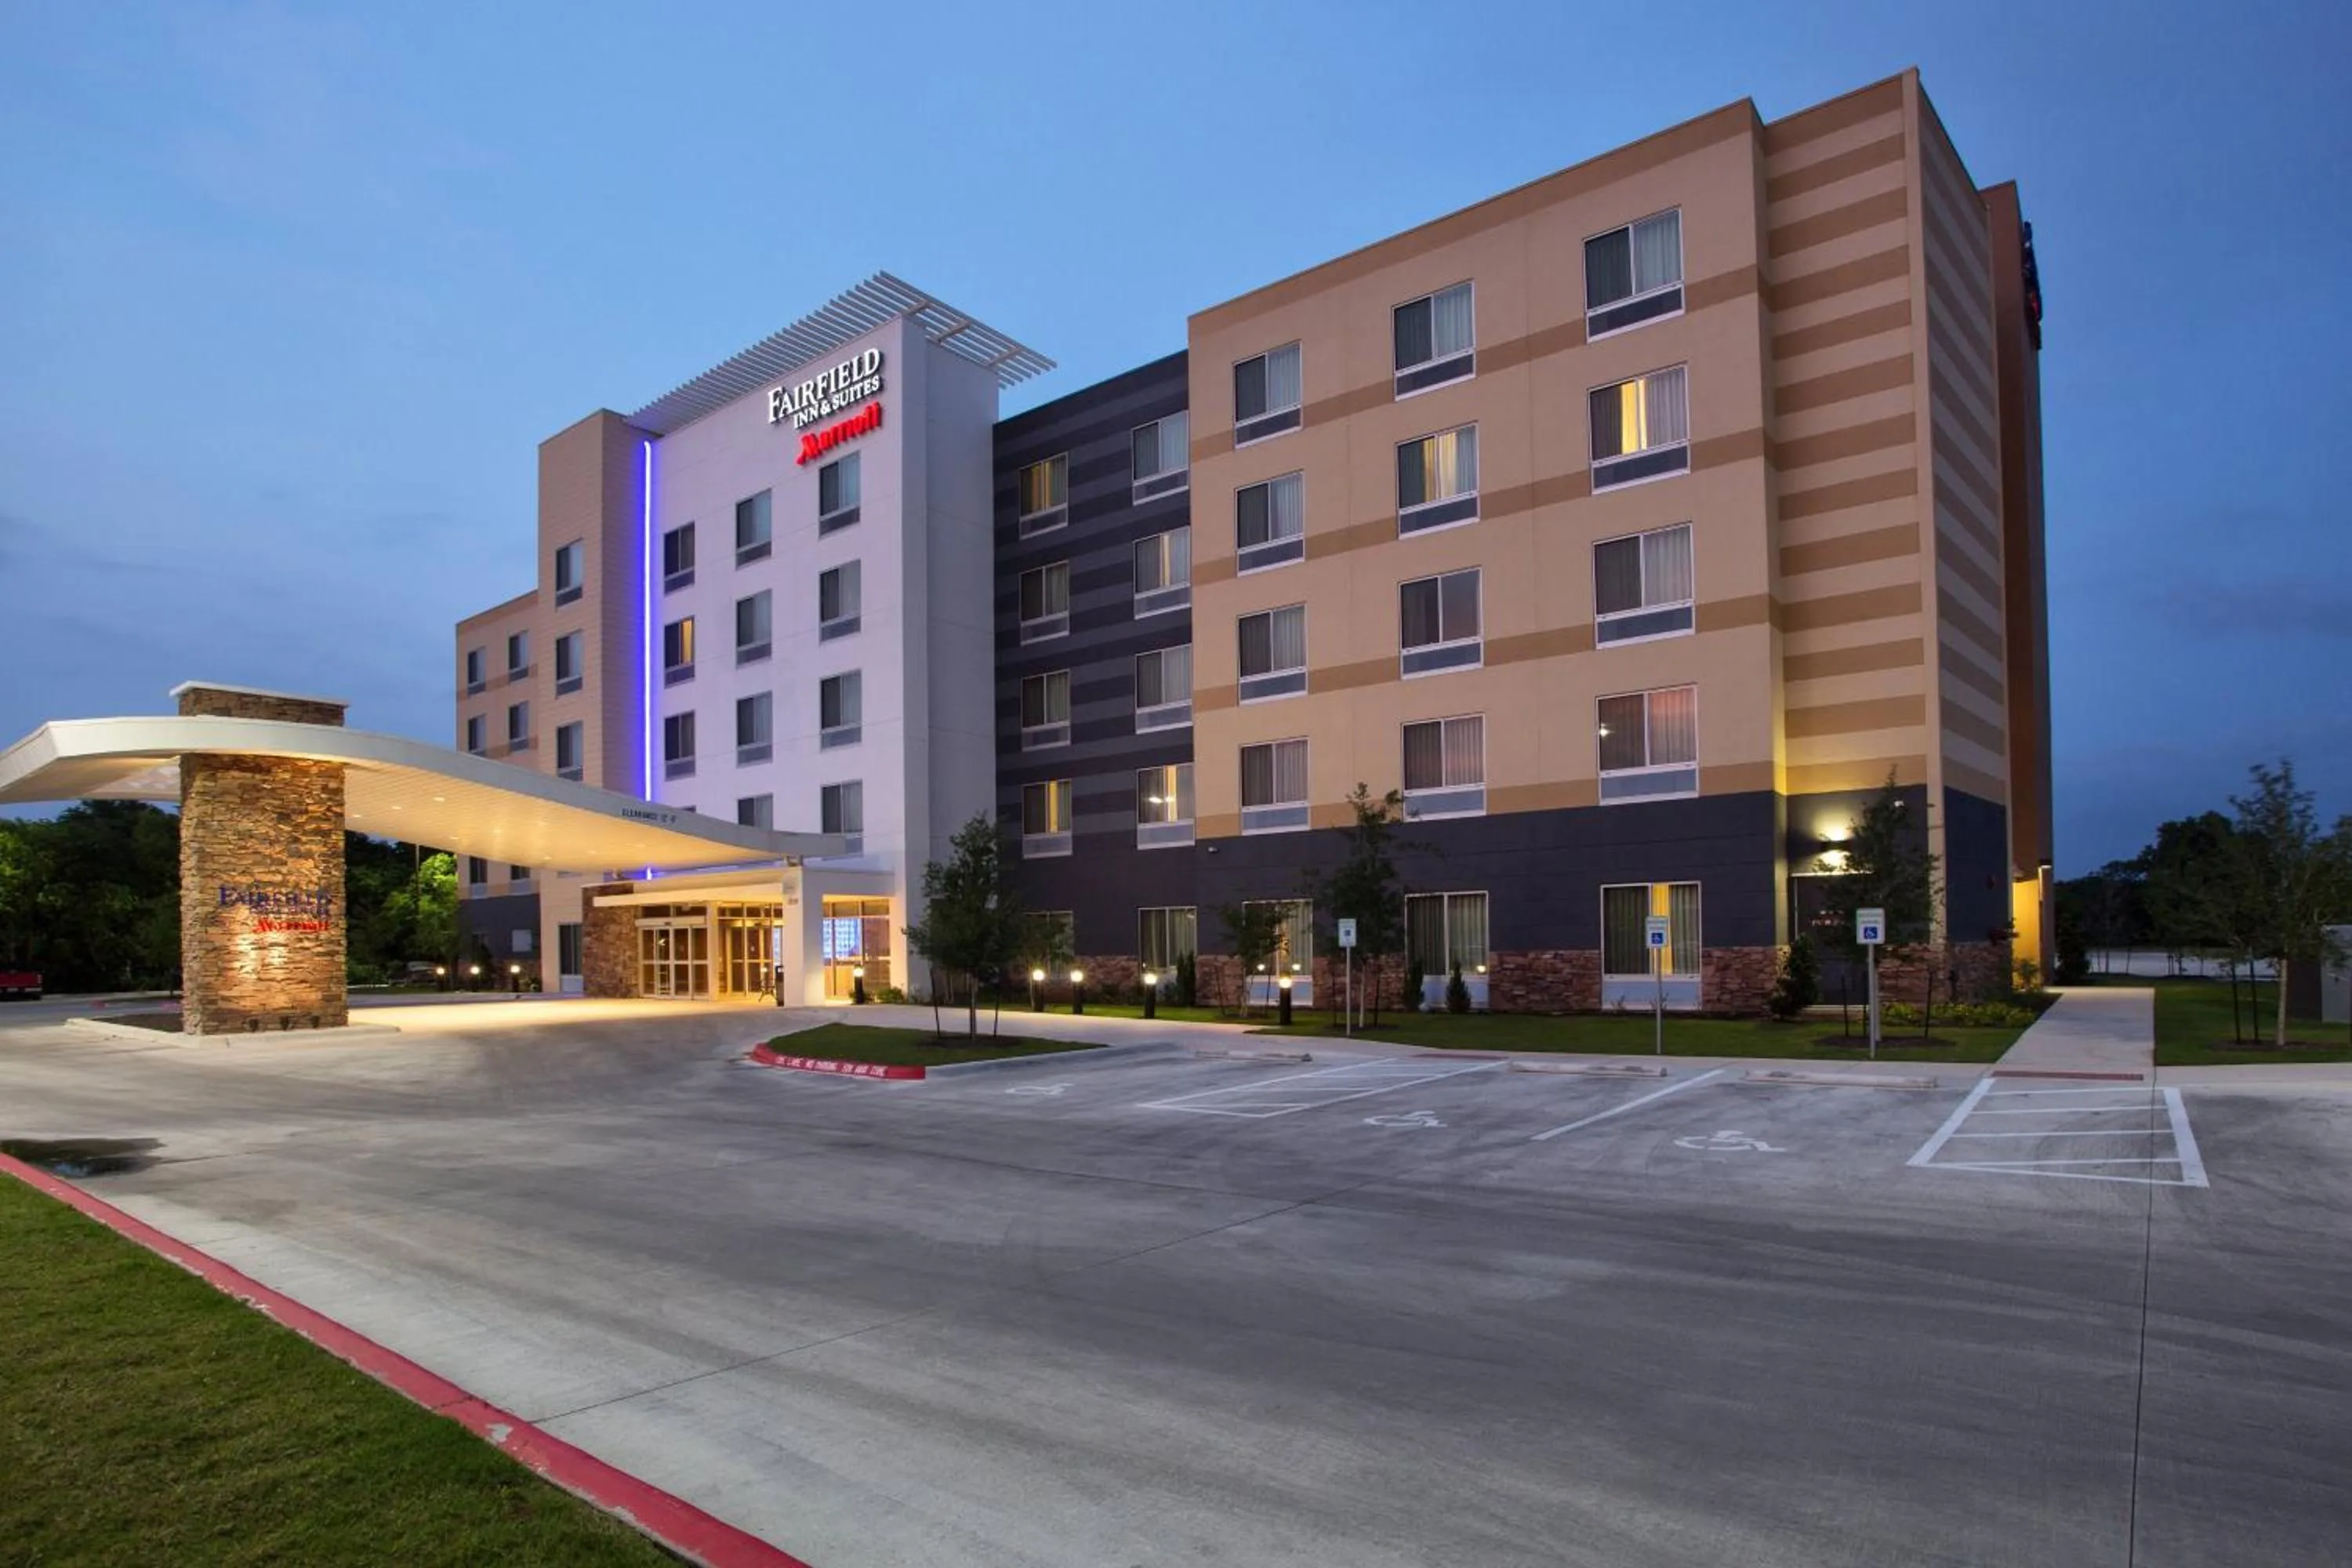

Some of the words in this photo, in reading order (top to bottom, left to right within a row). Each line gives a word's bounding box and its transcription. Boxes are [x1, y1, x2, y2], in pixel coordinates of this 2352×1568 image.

[768, 348, 880, 423] FAIRFIELD
[793, 400, 818, 429] INN
[820, 400, 832, 416] &
[832, 375, 880, 411] SUITES
[797, 401, 881, 466] Marriott
